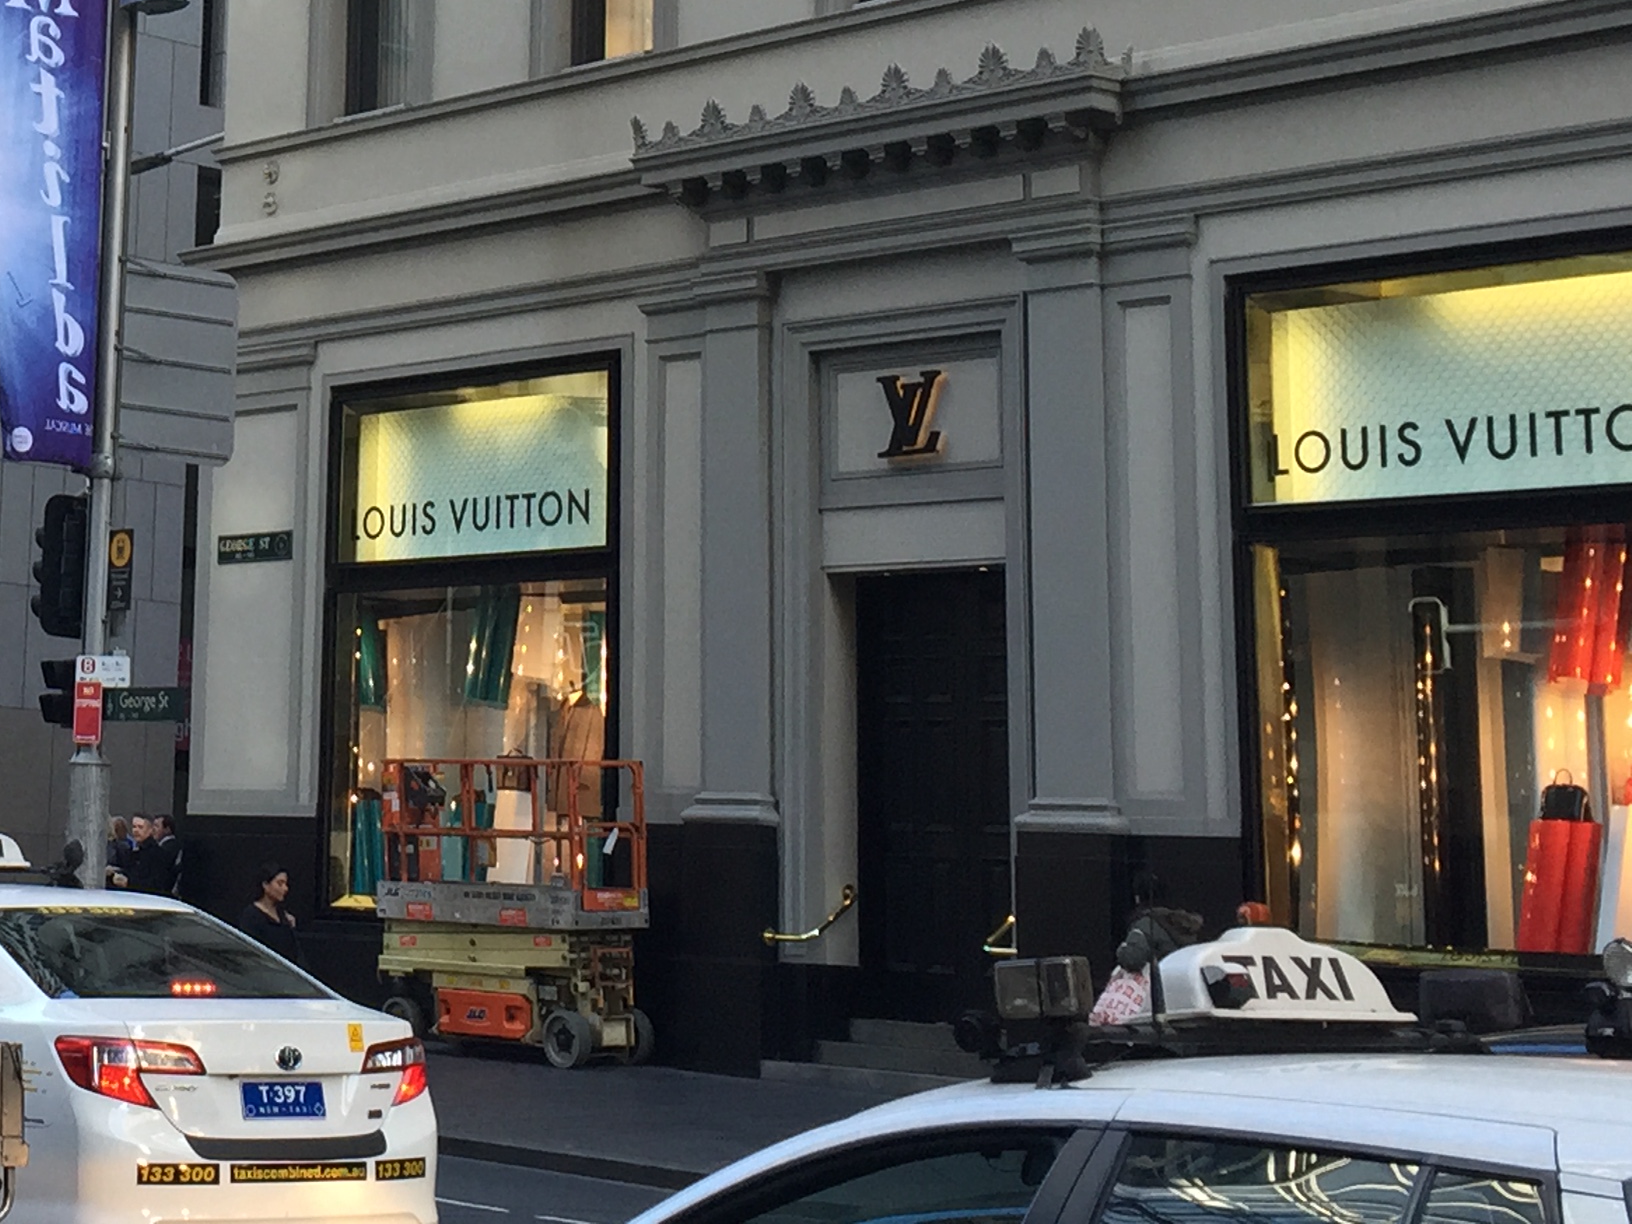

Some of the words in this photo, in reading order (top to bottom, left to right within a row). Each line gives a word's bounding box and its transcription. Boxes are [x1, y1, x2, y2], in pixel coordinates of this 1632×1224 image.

[1271, 421, 1422, 477] LOUIS
[1443, 403, 1632, 465] VUITTO
[450, 488, 591, 535] VUITTON
[120, 691, 156, 713] George
[158, 691, 169, 709] St
[1222, 954, 1355, 1001] TAXI
[140, 1166, 175, 1182] 133
[179, 1166, 216, 1182] 300
[232, 1165, 366, 1181] taxiscombined.com.au
[378, 1163, 400, 1178] 133
[402, 1161, 424, 1176] 300
